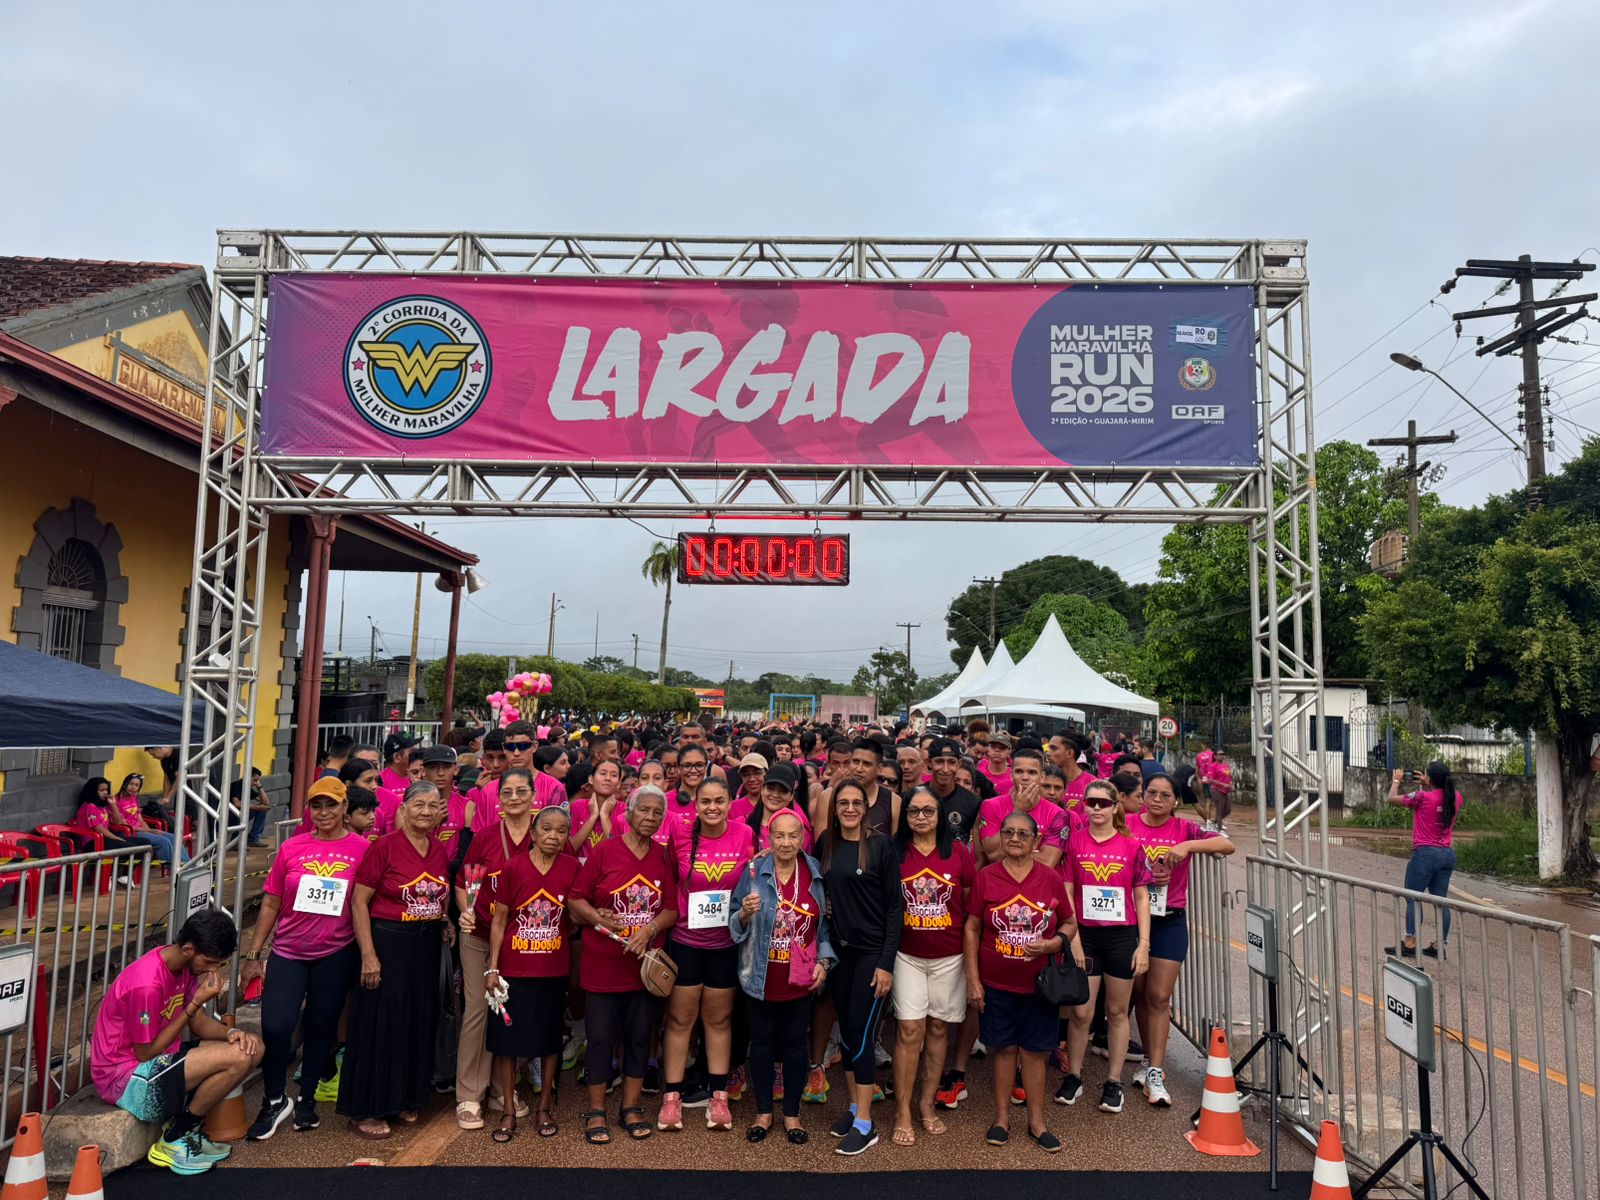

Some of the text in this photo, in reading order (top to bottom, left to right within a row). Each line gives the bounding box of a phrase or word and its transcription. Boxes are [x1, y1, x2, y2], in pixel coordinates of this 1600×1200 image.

[383, 305, 447, 324] CORRIDA
[450, 318, 467, 337] DA
[1051, 325, 1153, 341] MULHER
[1051, 341, 1153, 353] MARAVILHA
[548, 323, 971, 426] LARGADA
[1051, 353, 1154, 385] RUN
[353, 379, 481, 429] MULHER MARAVILHA
[1051, 385, 1154, 413] 2026
[1175, 406, 1220, 417] OAF
[1060, 416, 1088, 426] EDIÇÃO
[1094, 416, 1154, 425] GUAJARÁ-MIRIM
[686, 537, 843, 577] 00:00:00
[1162, 720, 1173, 730] 20
[307, 887, 335, 901] 3311
[698, 903, 722, 914] 3484
[1091, 897, 1115, 908] 3271
[512, 935, 562, 950] DOS IDOSOS
[0, 980, 23, 998] AF
[1388, 997, 1411, 1018] OAF
